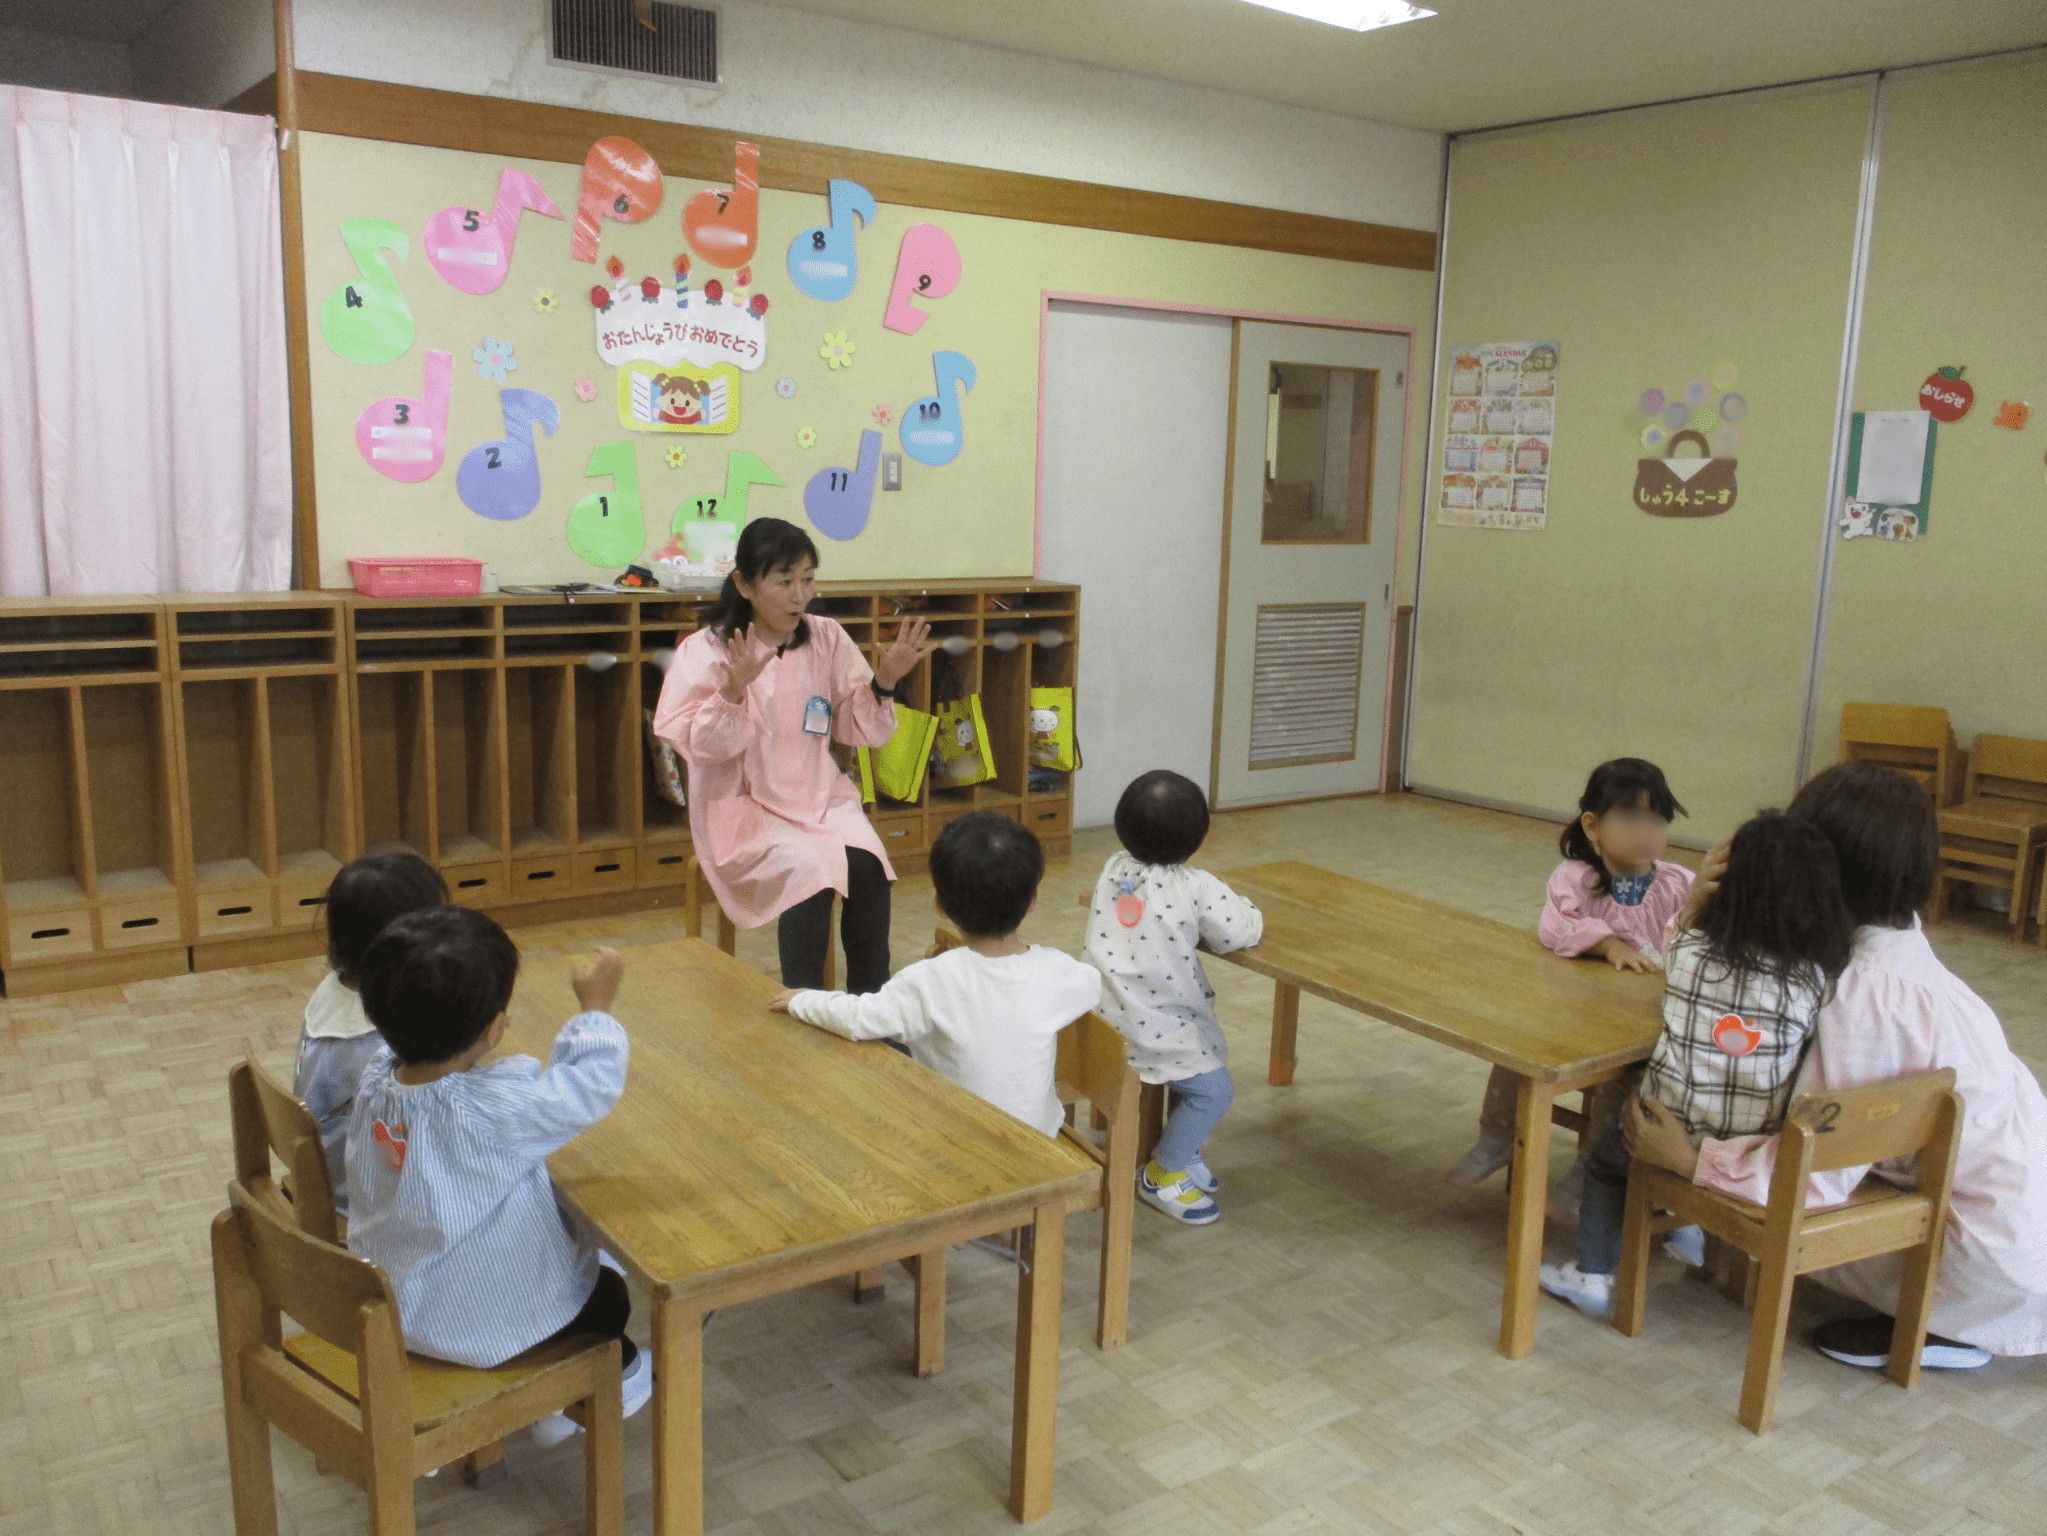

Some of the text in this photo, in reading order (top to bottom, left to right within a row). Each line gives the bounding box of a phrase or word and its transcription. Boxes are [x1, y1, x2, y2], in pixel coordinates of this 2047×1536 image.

[613, 194, 629, 214] 6
[717, 193, 730, 214] 7
[462, 209, 480, 232] 5
[811, 230, 827, 251] 8
[918, 274, 932, 292] 9
[345, 286, 363, 309] 4
[393, 403, 410, 425] 3
[919, 402, 942, 421] 10
[485, 447, 502, 470] 2
[831, 472, 848, 492] 11
[599, 496, 609, 517] 1
[696, 498, 718, 519] 12
[1814, 1102, 1842, 1134] 2
